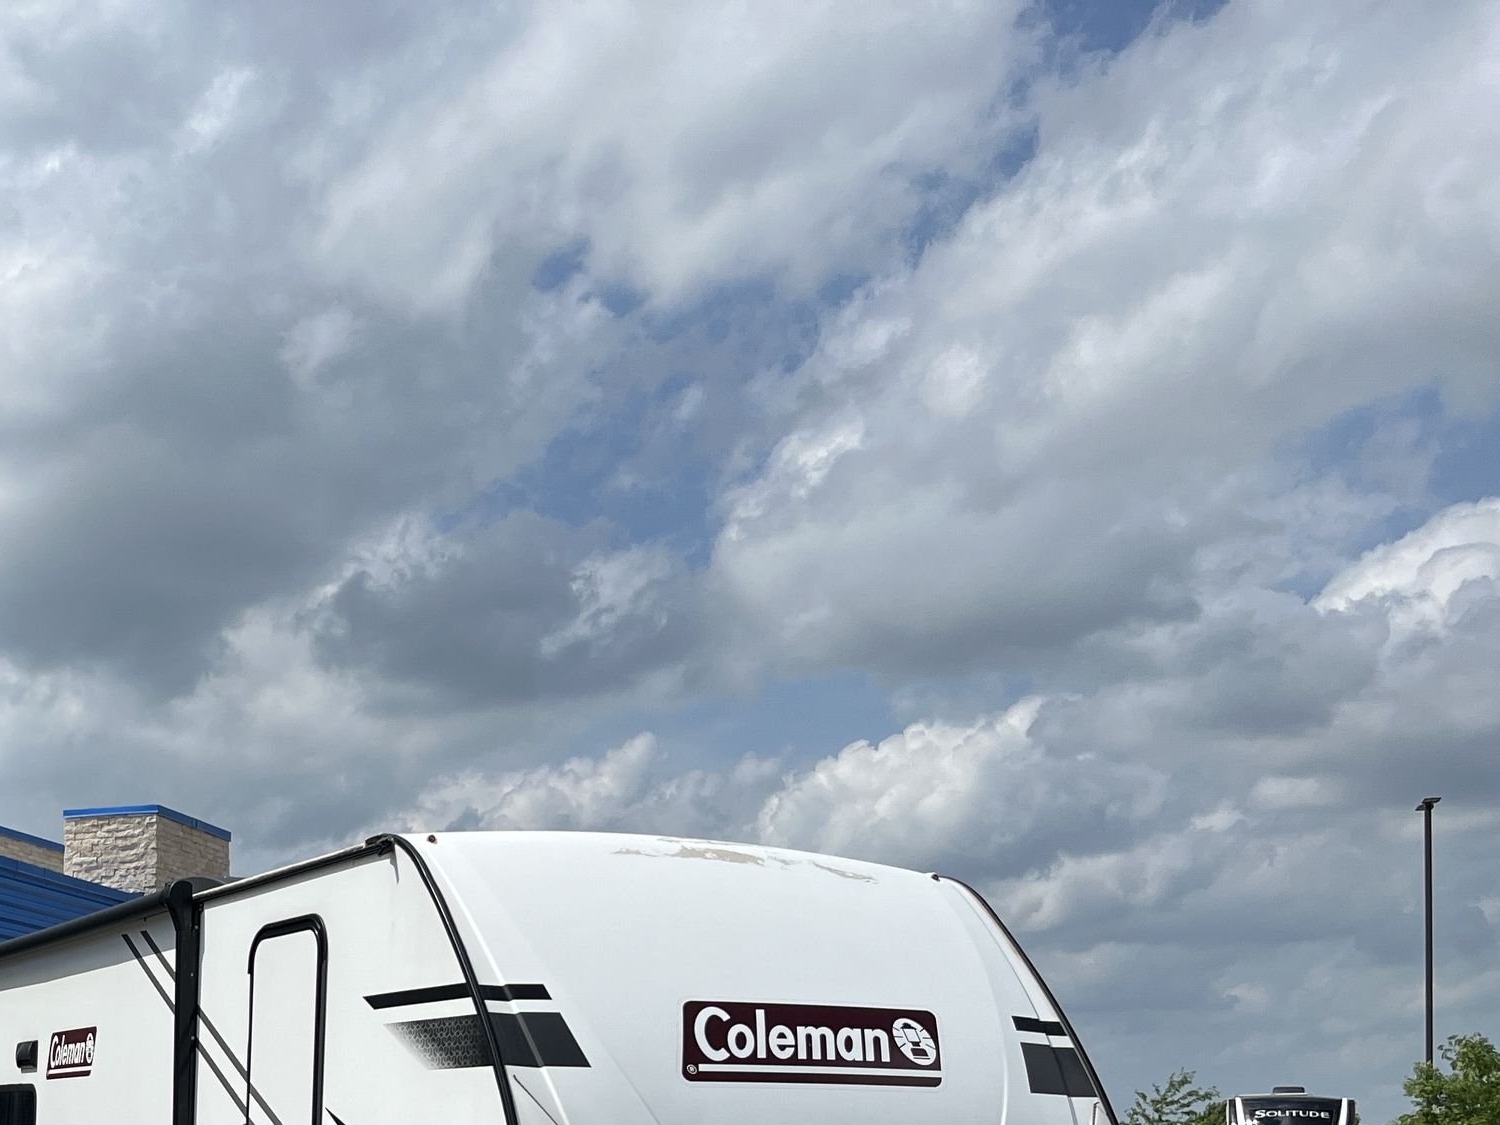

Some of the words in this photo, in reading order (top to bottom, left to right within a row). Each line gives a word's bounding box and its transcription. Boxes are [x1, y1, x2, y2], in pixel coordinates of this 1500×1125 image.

[50, 1034, 86, 1069] Coleman
[693, 1005, 891, 1063] Coleman
[1254, 1109, 1331, 1119] SOLITUDE
